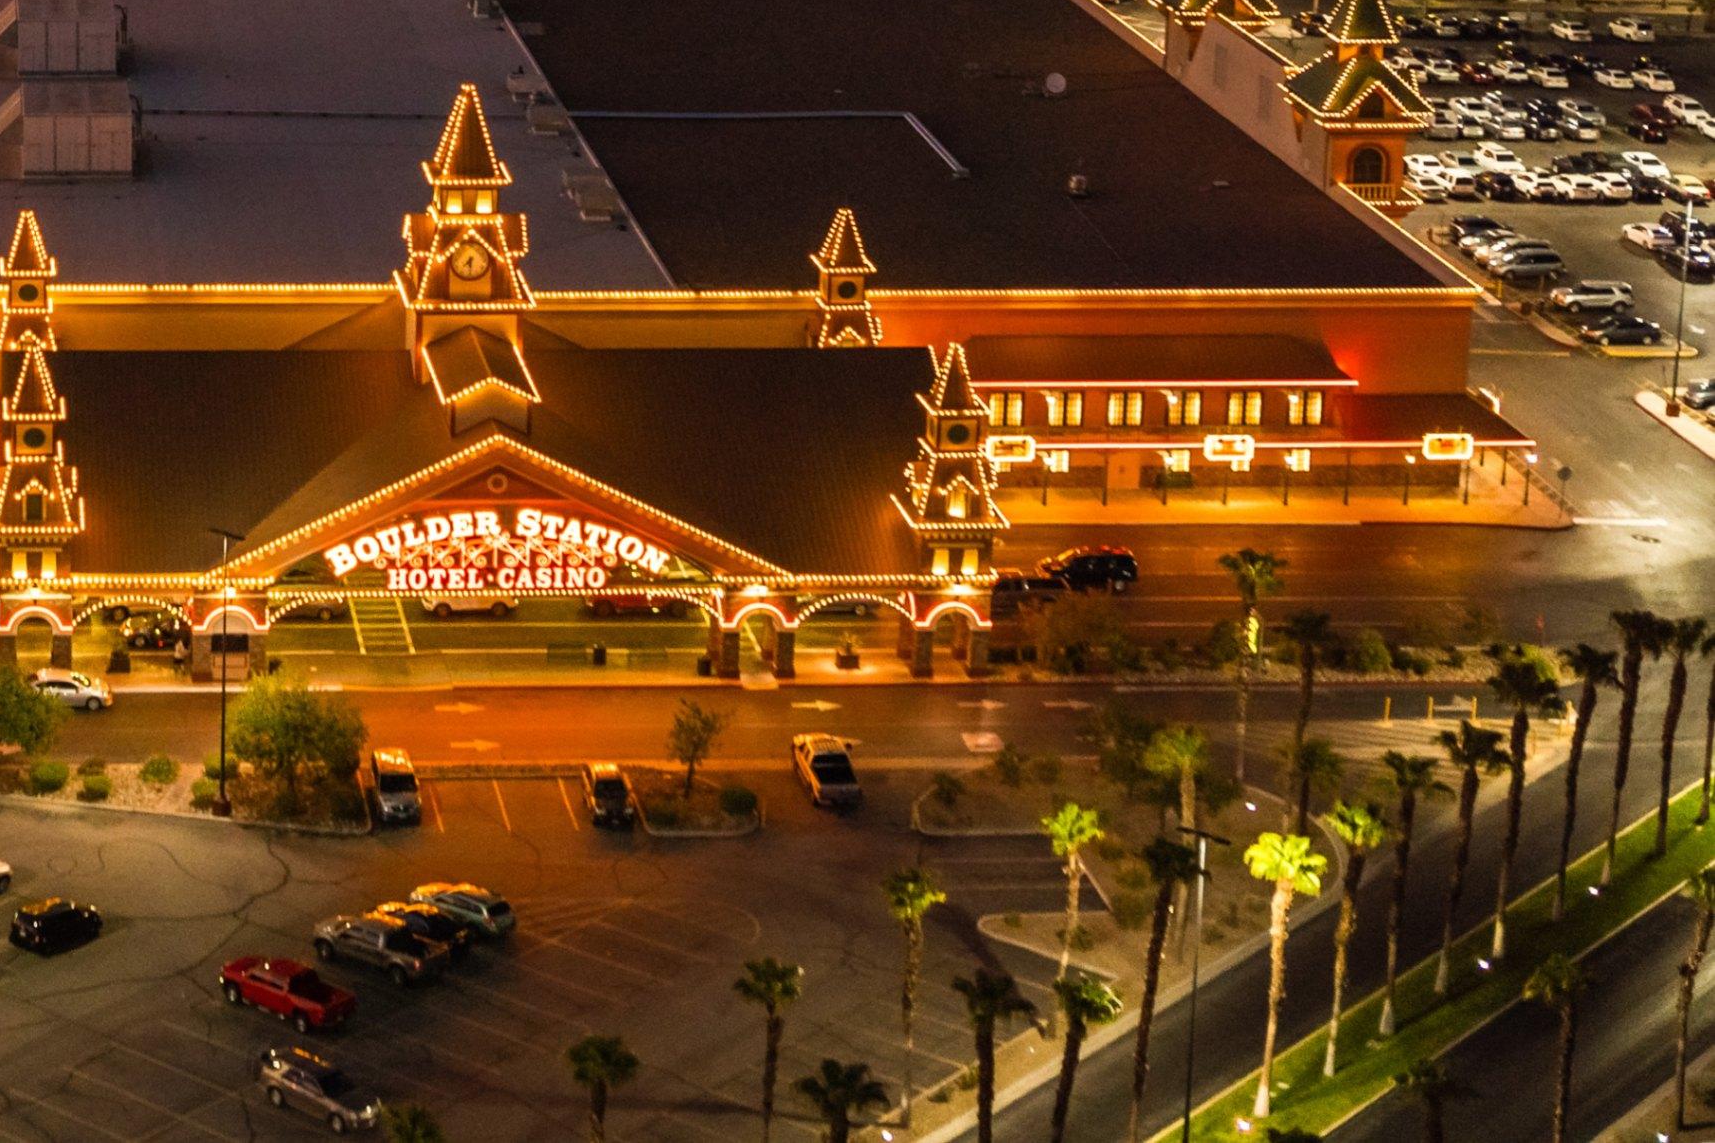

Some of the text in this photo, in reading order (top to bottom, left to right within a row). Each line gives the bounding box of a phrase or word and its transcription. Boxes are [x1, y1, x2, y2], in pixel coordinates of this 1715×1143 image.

[323, 508, 670, 577] BOULDER STATION
[388, 566, 605, 590] HOTEL CASINO
